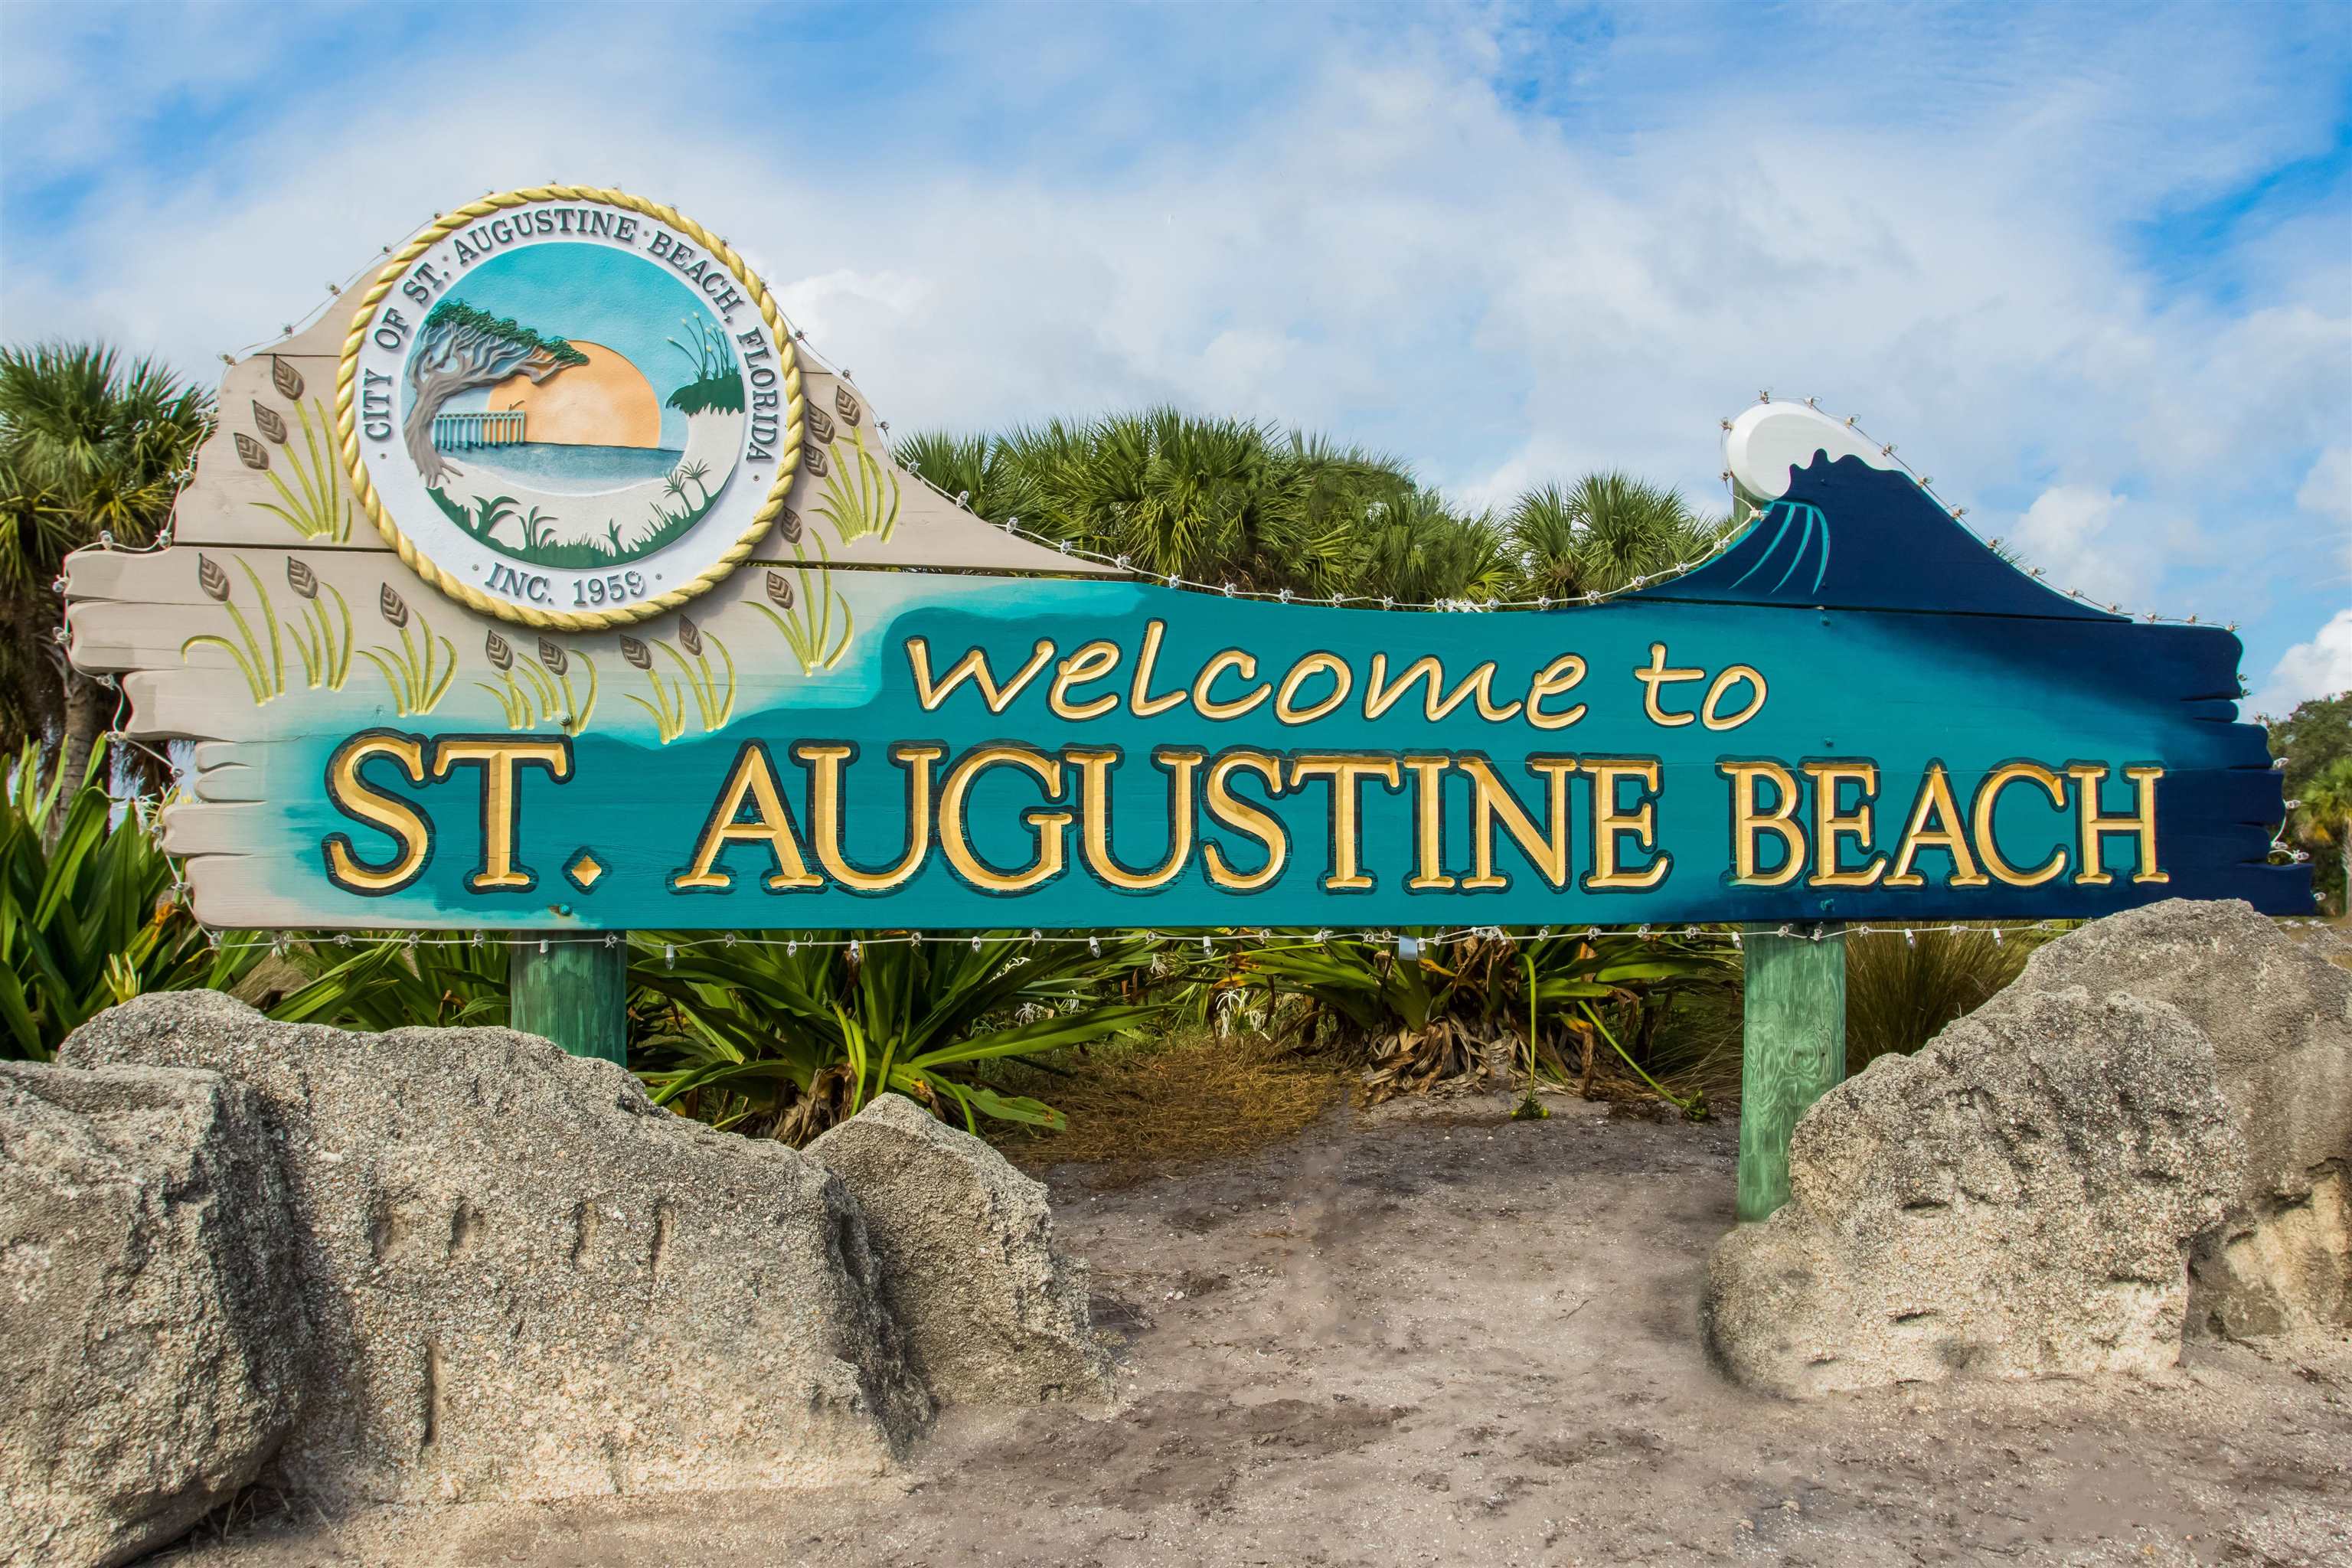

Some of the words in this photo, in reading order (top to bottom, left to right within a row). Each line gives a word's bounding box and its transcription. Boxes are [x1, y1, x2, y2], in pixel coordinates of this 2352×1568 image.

[453, 207, 639, 266] AUGUSTINE
[403, 263, 449, 305] ST.
[648, 230, 746, 323] BEACH,
[374, 308, 410, 351] OF
[364, 368, 394, 442] CITY
[736, 326, 779, 464] FLORIDA
[484, 561, 553, 603] INC.
[573, 570, 645, 607] 1959
[906, 617, 1588, 731] welcome
[1634, 640, 1767, 731] to
[322, 727, 609, 895] ST.
[666, 737, 1673, 897] AUGUSTINE
[1716, 756, 2173, 891] BEACH
